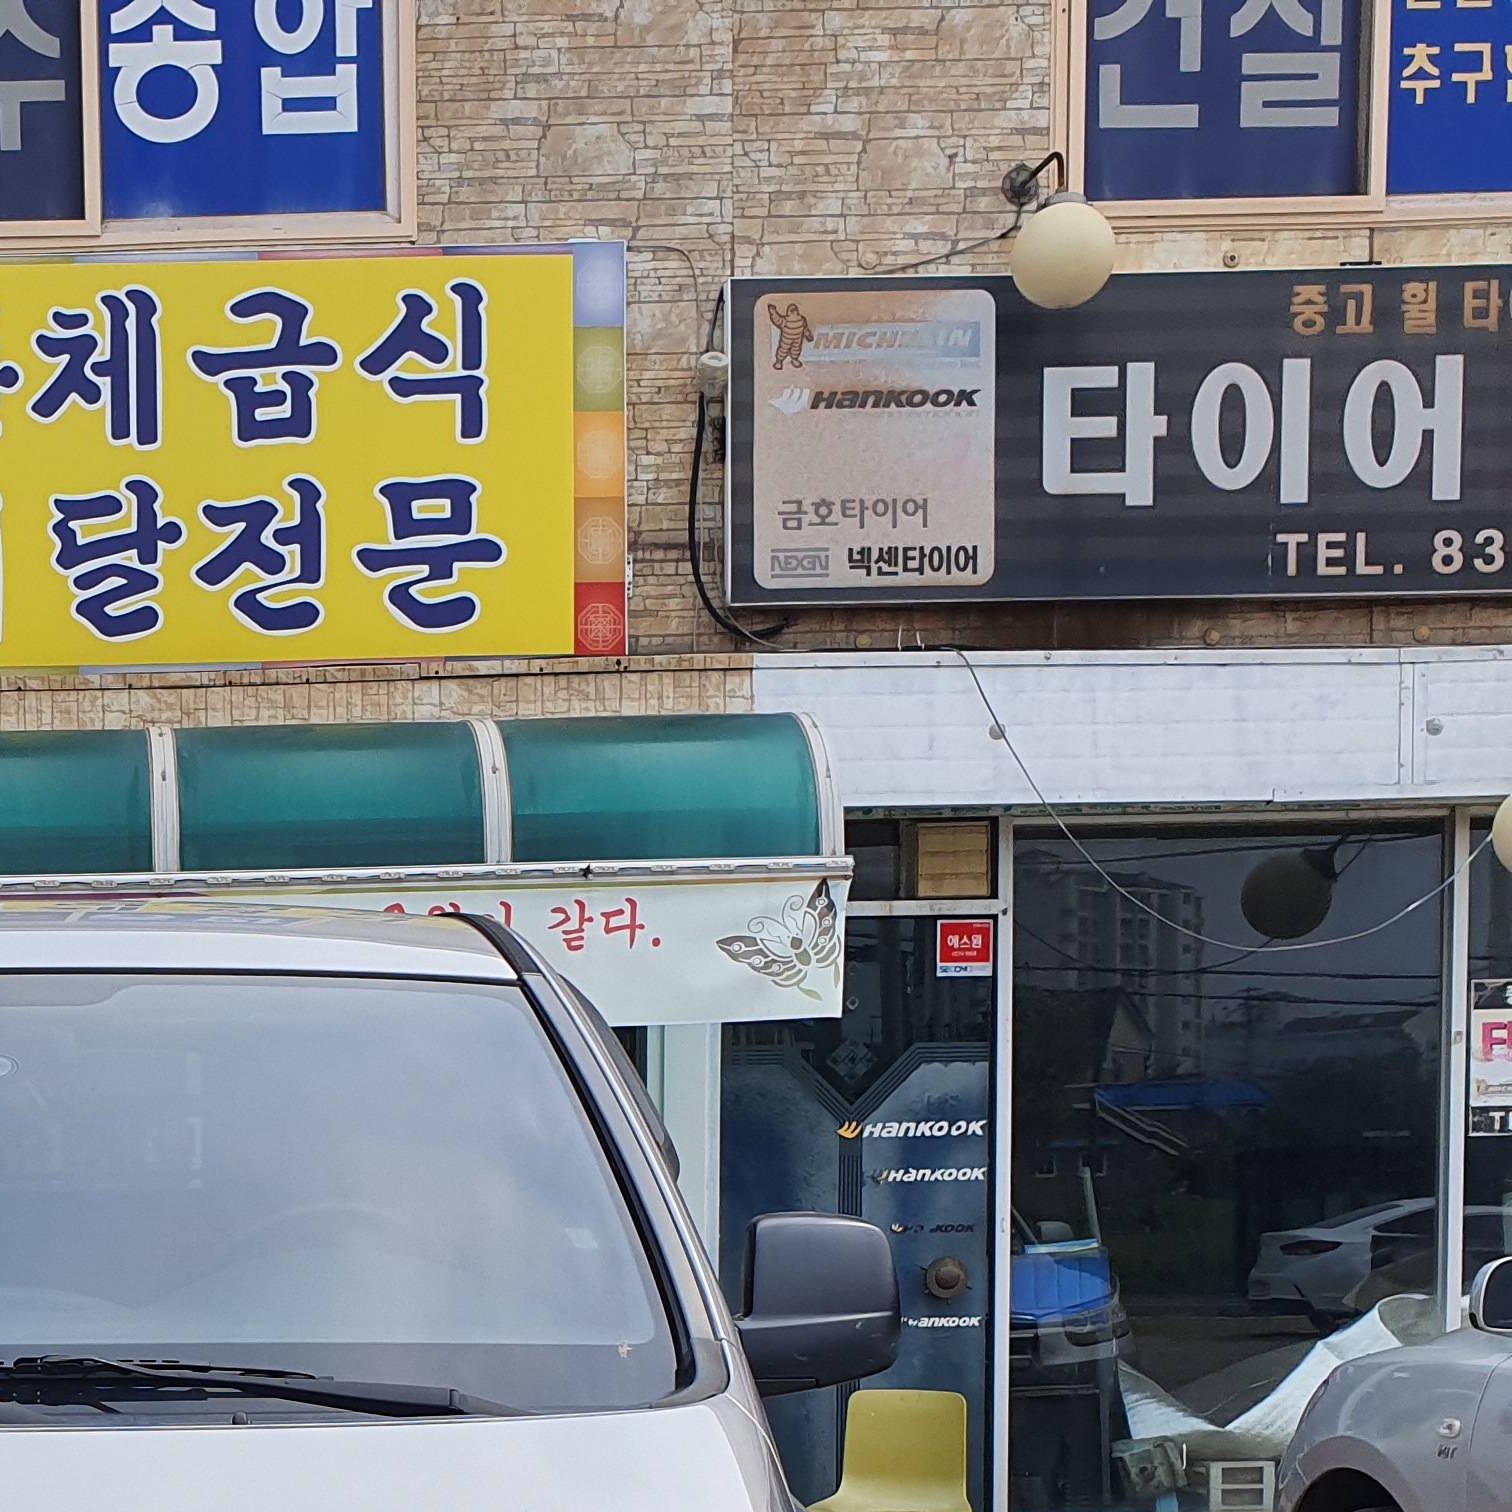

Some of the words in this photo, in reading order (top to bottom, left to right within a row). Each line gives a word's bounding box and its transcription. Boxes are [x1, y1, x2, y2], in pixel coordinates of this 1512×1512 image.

[1400, 43, 1512, 105] 추구
[1289, 279, 1375, 337] 중고
[1463, 279, 1512, 332] 타
[1041, 353, 1465, 508] 타이어
[777, 497, 929, 532] 금호타이어
[847, 544, 979, 578] 넥센타이어
[1275, 531, 1404, 578] TEL.
[546, 898, 662, 952] 같다.
[946, 933, 983, 949] 에스원
